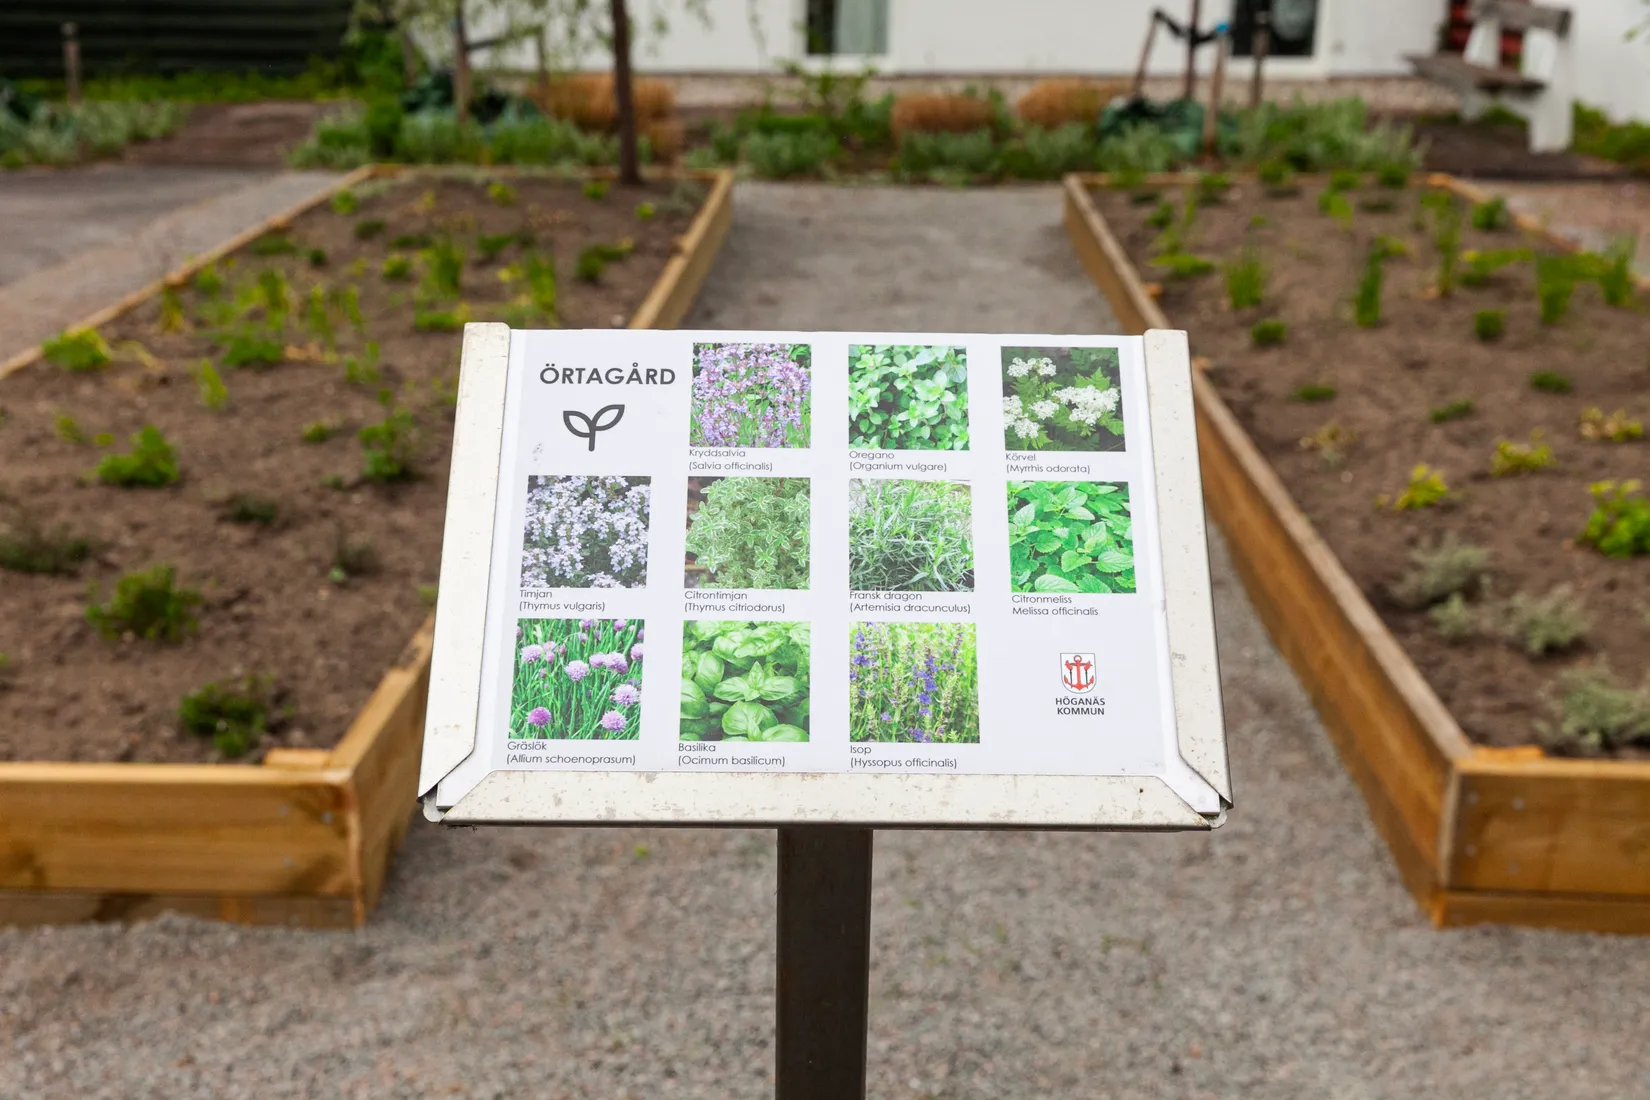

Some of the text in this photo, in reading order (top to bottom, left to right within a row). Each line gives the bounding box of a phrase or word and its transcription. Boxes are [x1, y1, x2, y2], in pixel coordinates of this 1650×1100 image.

[539, 362, 676, 385] ÖRTAGÅRD
[689, 449, 746, 458] Kryddsalvia
[849, 451, 895, 460] Oregano
[689, 462, 773, 471] (Salvia officinalis)
[849, 462, 947, 472] (Organium vulgare)
[1006, 464, 1090, 474] (Myrrhis odorata)
[520, 590, 552, 599] Timjan
[685, 591, 748, 601] Citrontimjan
[849, 592, 922, 601] Fransk dragon
[1012, 595, 1072, 603] Citronmeliss
[519, 602, 605, 612] (Thymus vulgaris)
[684, 603, 785, 613] (Thymus citriodorus)
[850, 603, 971, 613] (Artemisia dracunculus)
[1013, 607, 1098, 615] Melissa officinalis
[1055, 696, 1105, 705] HÖGANÄS
[1057, 707, 1105, 715] KOMMUN
[507, 741, 547, 751] Gräslök
[679, 743, 716, 752] Basilika
[850, 745, 871, 755] Isop
[507, 754, 636, 765] (Allium schoenoprasum)
[678, 756, 785, 766] (Ocimum basilicum)
[850, 758, 957, 769] (Hyssopus officinalis)
